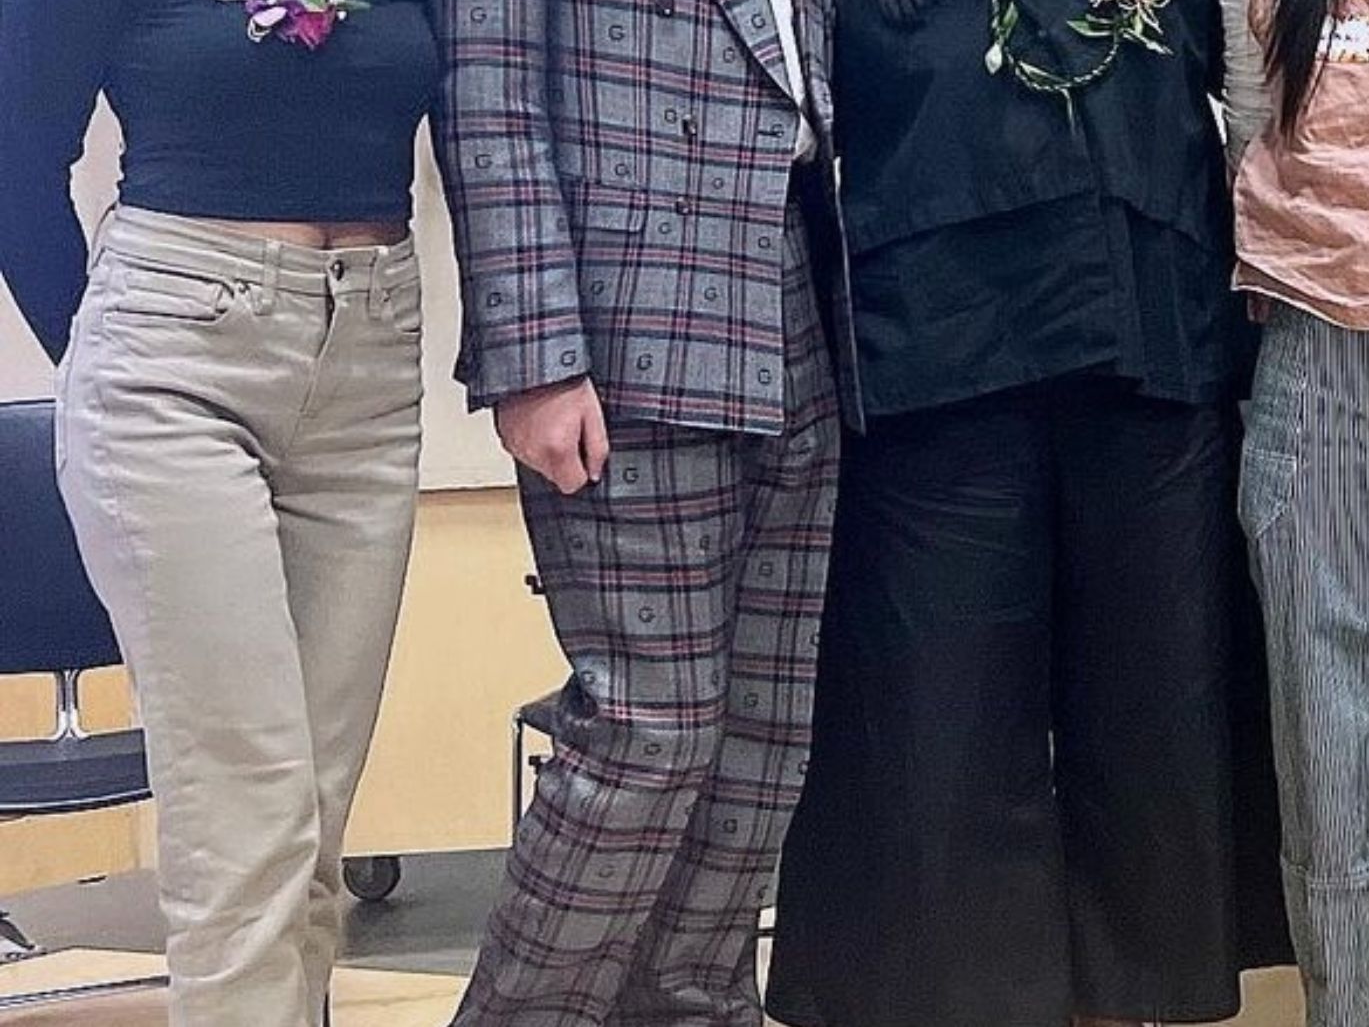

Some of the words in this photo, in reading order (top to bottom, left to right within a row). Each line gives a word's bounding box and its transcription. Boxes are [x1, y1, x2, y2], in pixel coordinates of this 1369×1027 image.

[470, 7, 487, 23] G
[608, 25, 625, 41] G
[622, 468, 639, 484] G
